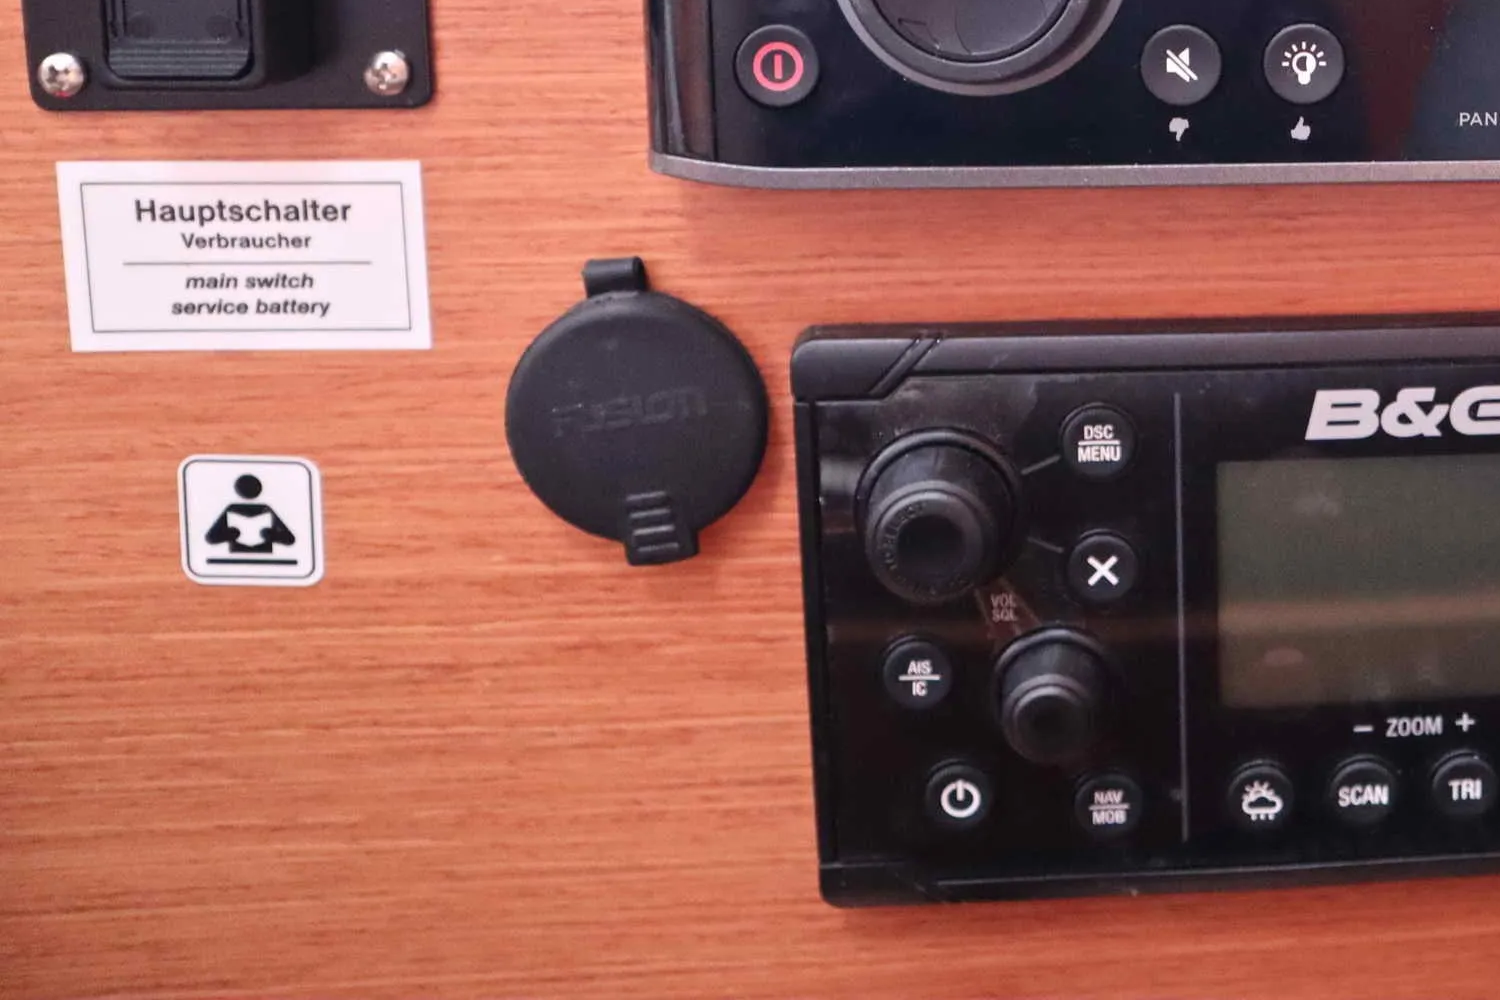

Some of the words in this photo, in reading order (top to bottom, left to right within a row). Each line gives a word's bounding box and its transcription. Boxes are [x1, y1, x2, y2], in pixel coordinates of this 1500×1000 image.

[134, 198, 352, 228] Hauptschalter
[181, 231, 312, 250] Verbraucher
[185, 273, 239, 291] main
[245, 272, 315, 290] switch
[171, 300, 249, 316] service
[256, 299, 331, 319] battery
[1083, 424, 1114, 440] DSC
[1077, 445, 1122, 463] MENU
[990, 592, 1017, 608] VOL
[907, 659, 932, 675] AIS
[912, 681, 928, 697] IC
[1386, 716, 1443, 738] ZOOM
[1094, 790, 1123, 805] NAV
[1338, 783, 1390, 807] SCAN
[1448, 778, 1482, 801] TRI
[1091, 808, 1127, 825] MOB
